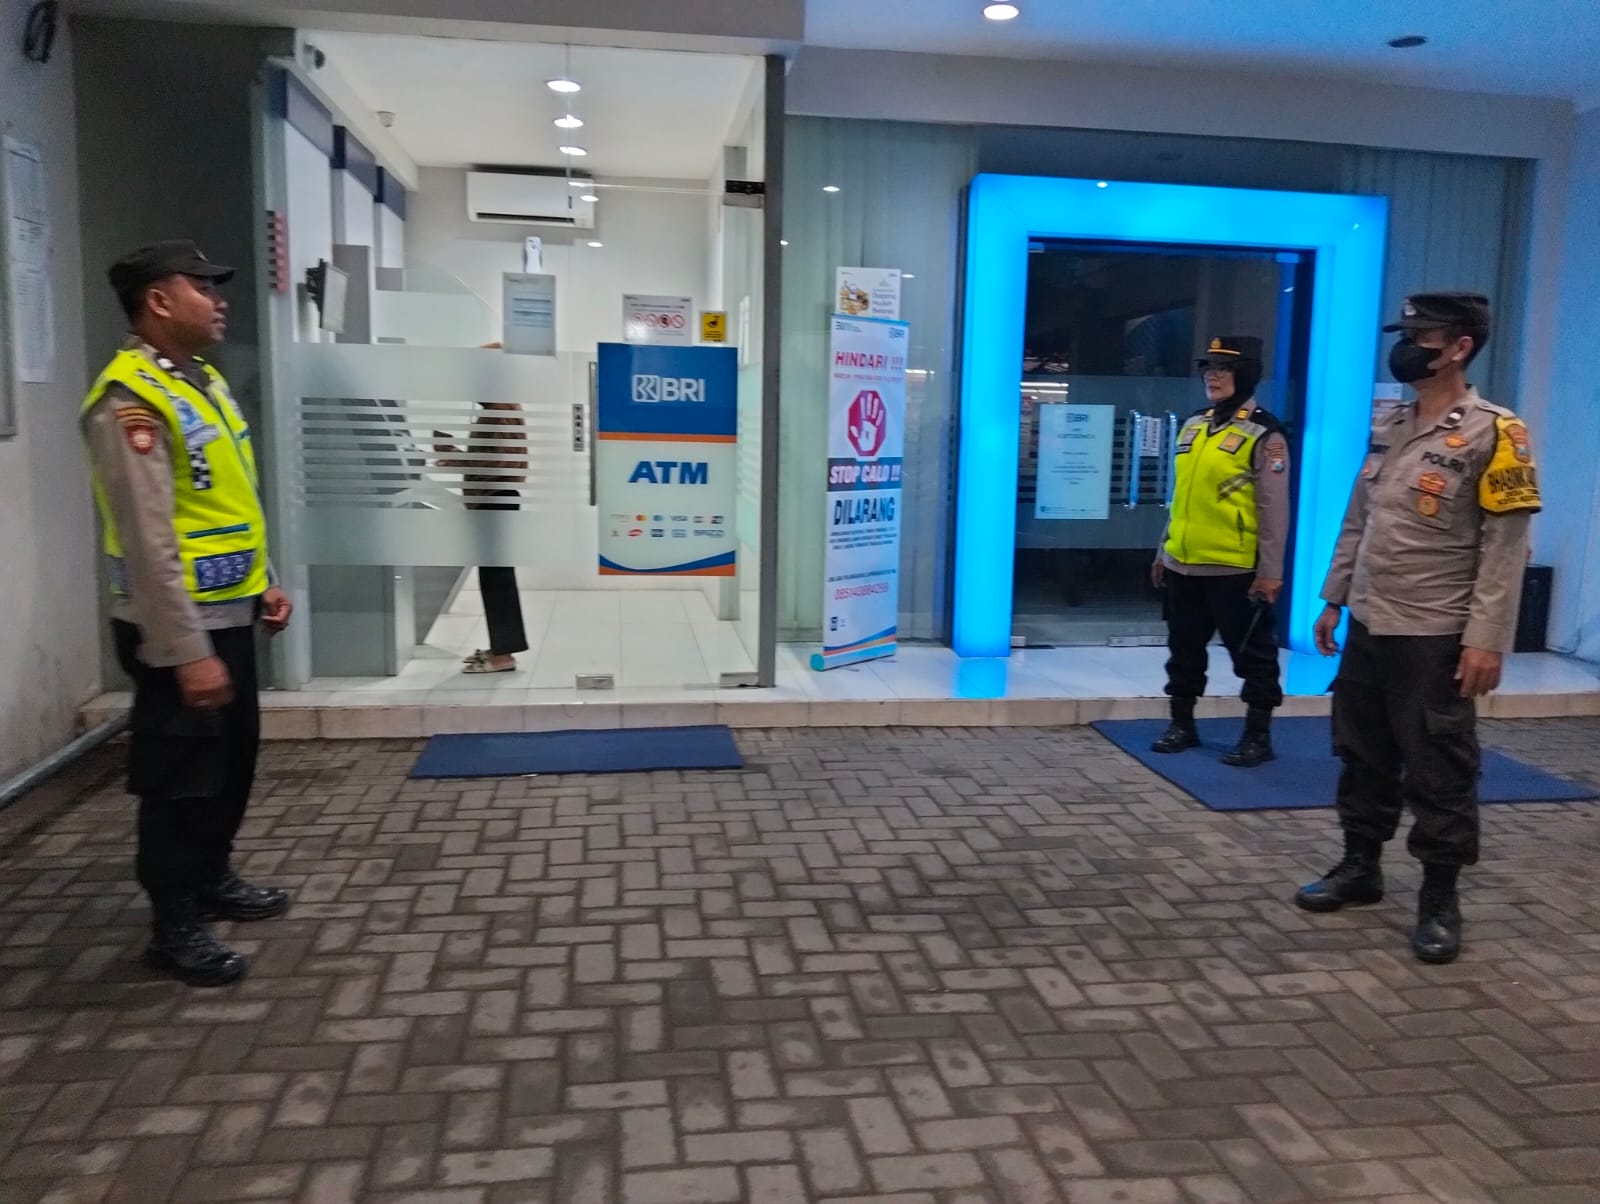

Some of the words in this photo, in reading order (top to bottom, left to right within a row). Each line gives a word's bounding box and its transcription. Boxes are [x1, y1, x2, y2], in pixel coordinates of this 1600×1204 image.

[835, 352, 888, 369] HINDARI
[662, 377, 705, 402] BRI
[1421, 451, 1464, 472] POLRI
[628, 461, 708, 485] ATM
[829, 465, 860, 484] STOP
[861, 465, 890, 483] CALO
[834, 496, 895, 525] DILARANG
